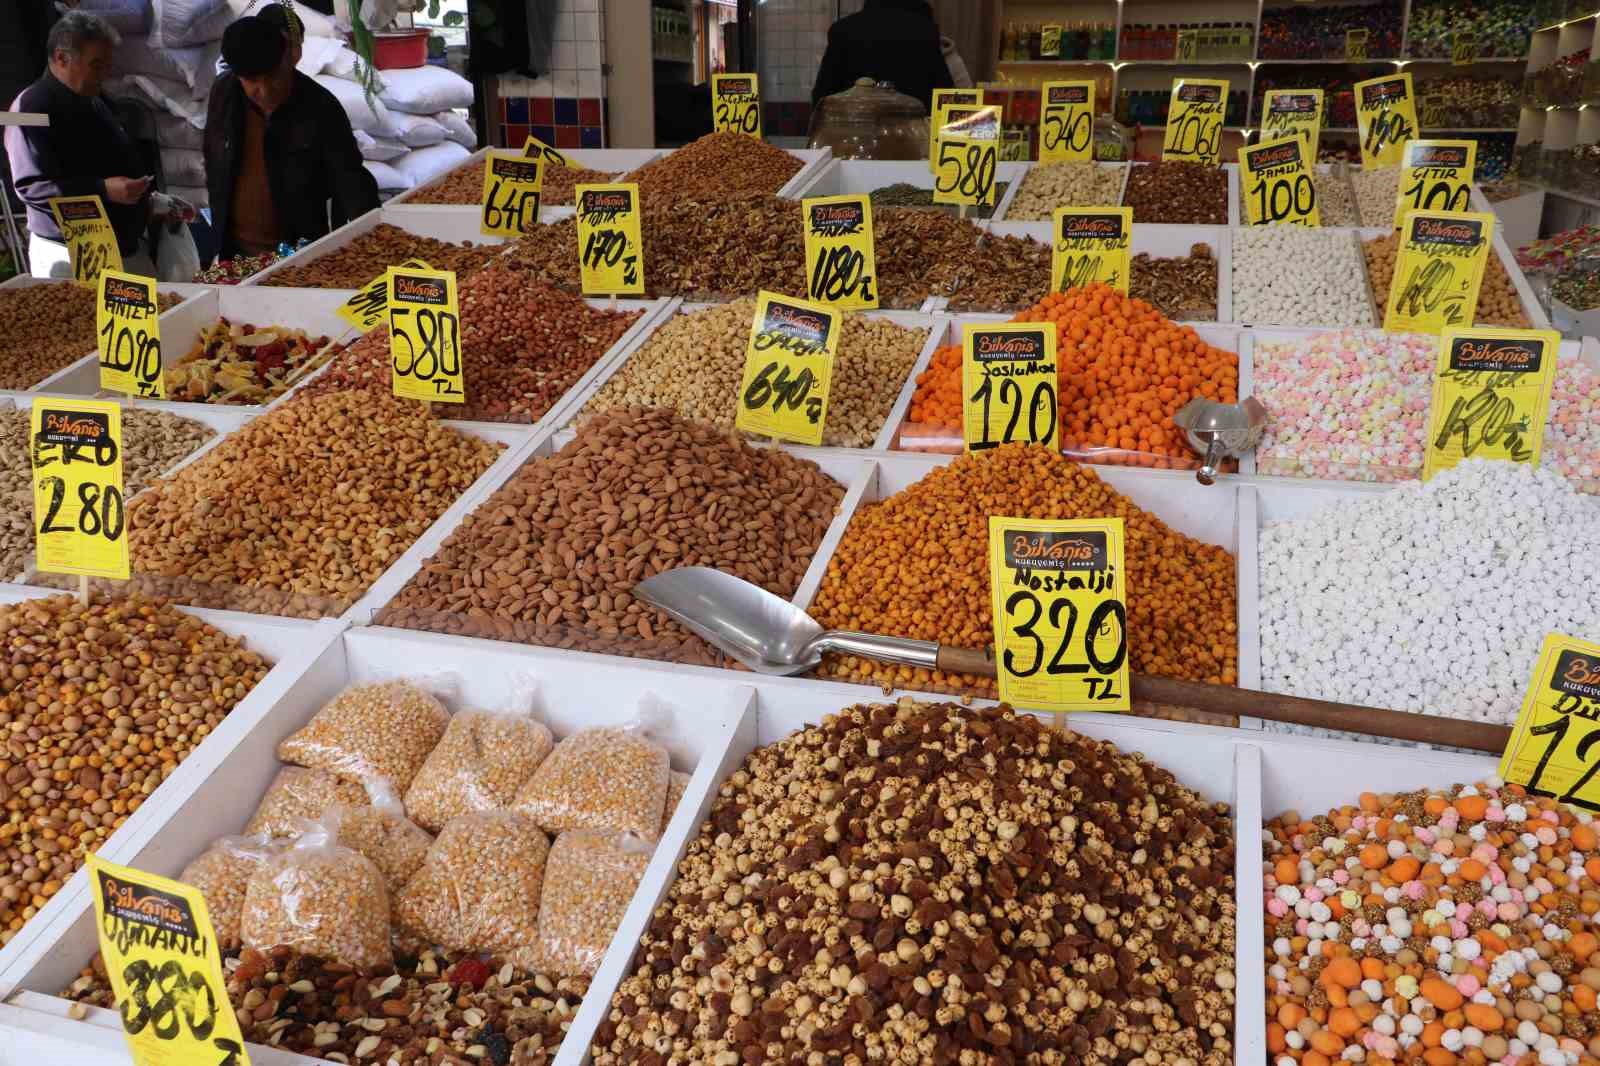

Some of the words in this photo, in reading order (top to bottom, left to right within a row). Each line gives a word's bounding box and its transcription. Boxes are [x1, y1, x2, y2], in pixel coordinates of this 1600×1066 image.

[1044, 105, 1093, 153] 540
[1164, 111, 1223, 156] 1060
[935, 140, 996, 199] 580
[484, 180, 541, 234] 640
[1252, 174, 1315, 226] 100
[1405, 180, 1471, 212] 100
[811, 245, 864, 301] 1180
[104, 302, 157, 321] ANTEP
[100, 317, 161, 383] 1090
[390, 308, 460, 381] 580
[137, 382, 160, 398] TL
[431, 378, 464, 395] TL
[969, 375, 1057, 450] 120
[39, 475, 125, 542] 280
[1012, 535, 1095, 561] Bilvanis
[1013, 565, 1115, 594] Nostalji
[1003, 590, 1127, 677] 320
[1083, 678, 1122, 700] TL
[119, 959, 219, 1042] 380
